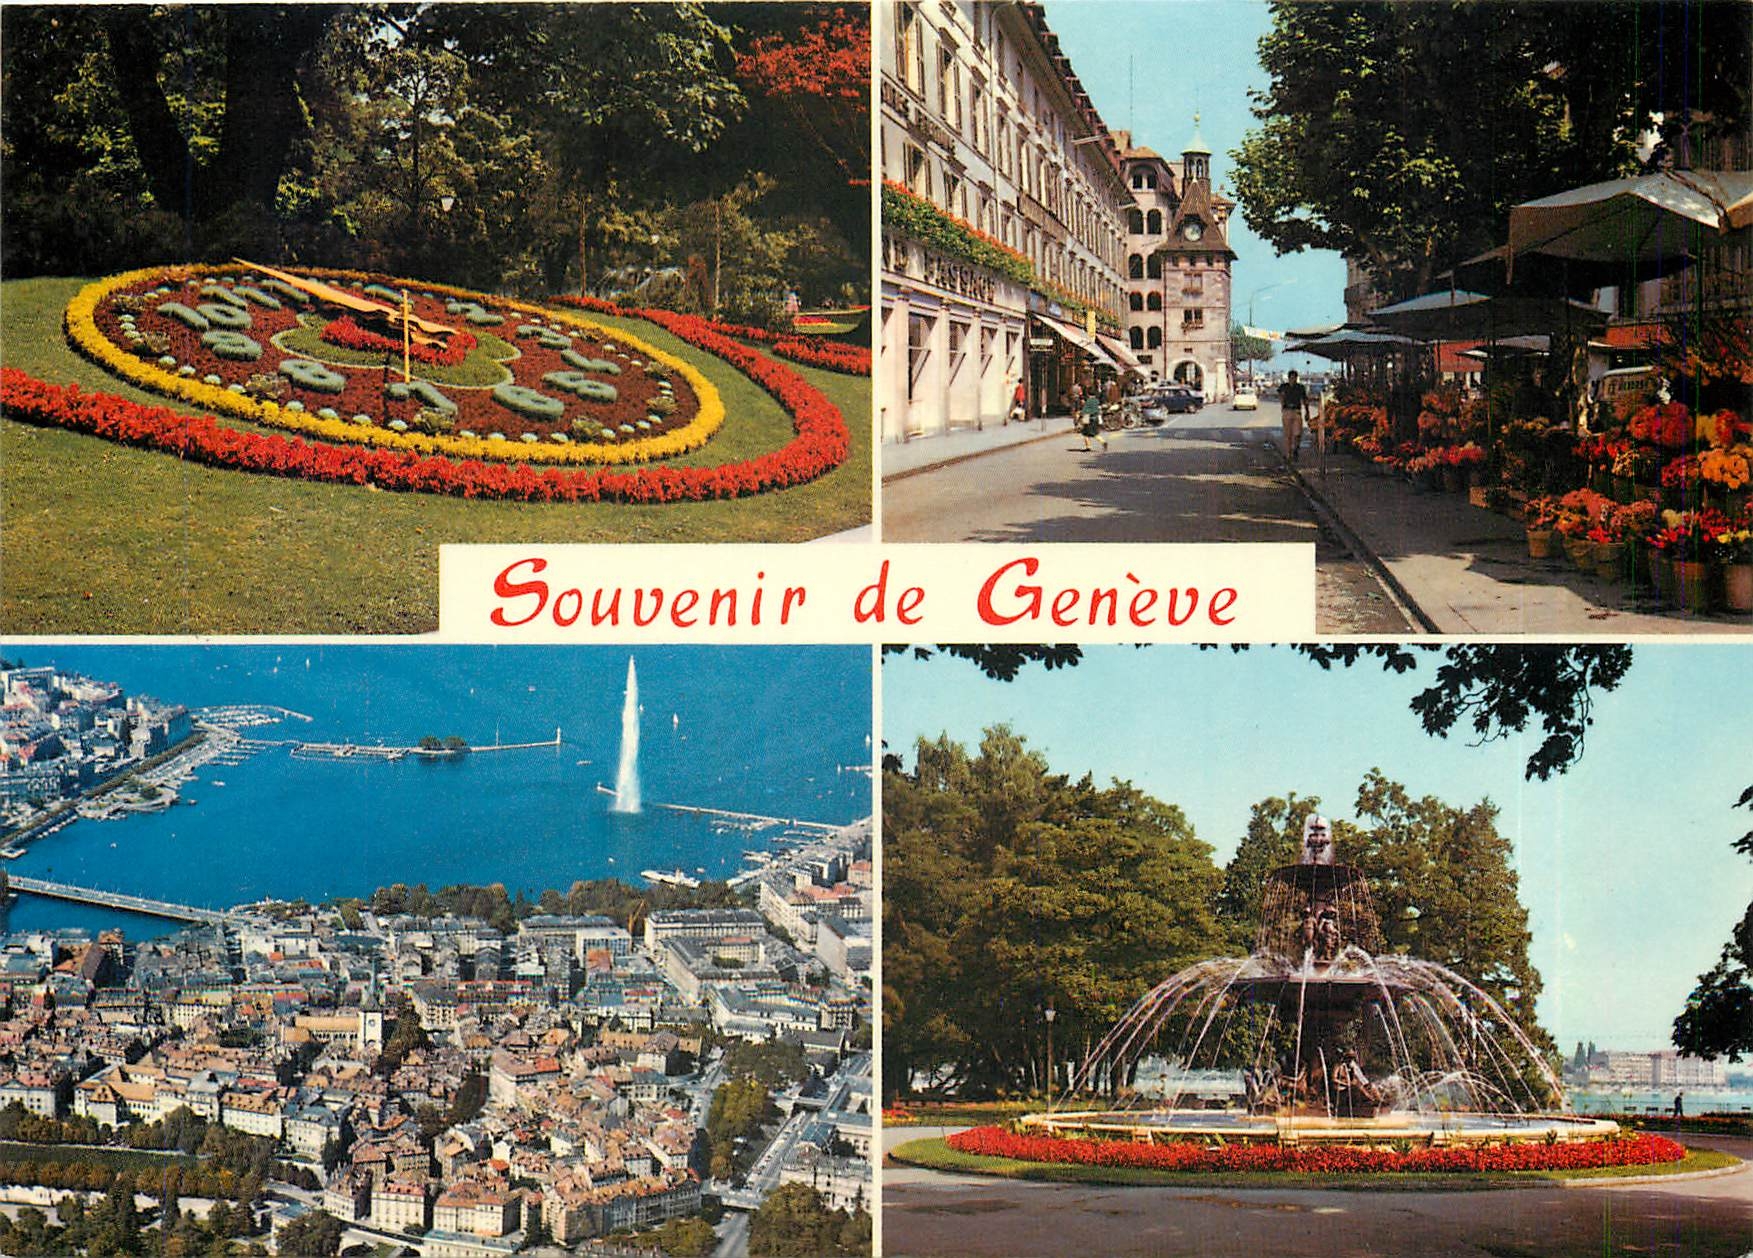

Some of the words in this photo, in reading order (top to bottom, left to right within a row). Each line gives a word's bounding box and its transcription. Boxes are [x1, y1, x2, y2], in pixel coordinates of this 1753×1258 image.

[157, 301, 252, 330] 10
[201, 329, 263, 362] 9
[278, 358, 346, 394] 8
[384, 380, 459, 416] 7
[492, 384, 565, 420] 6
